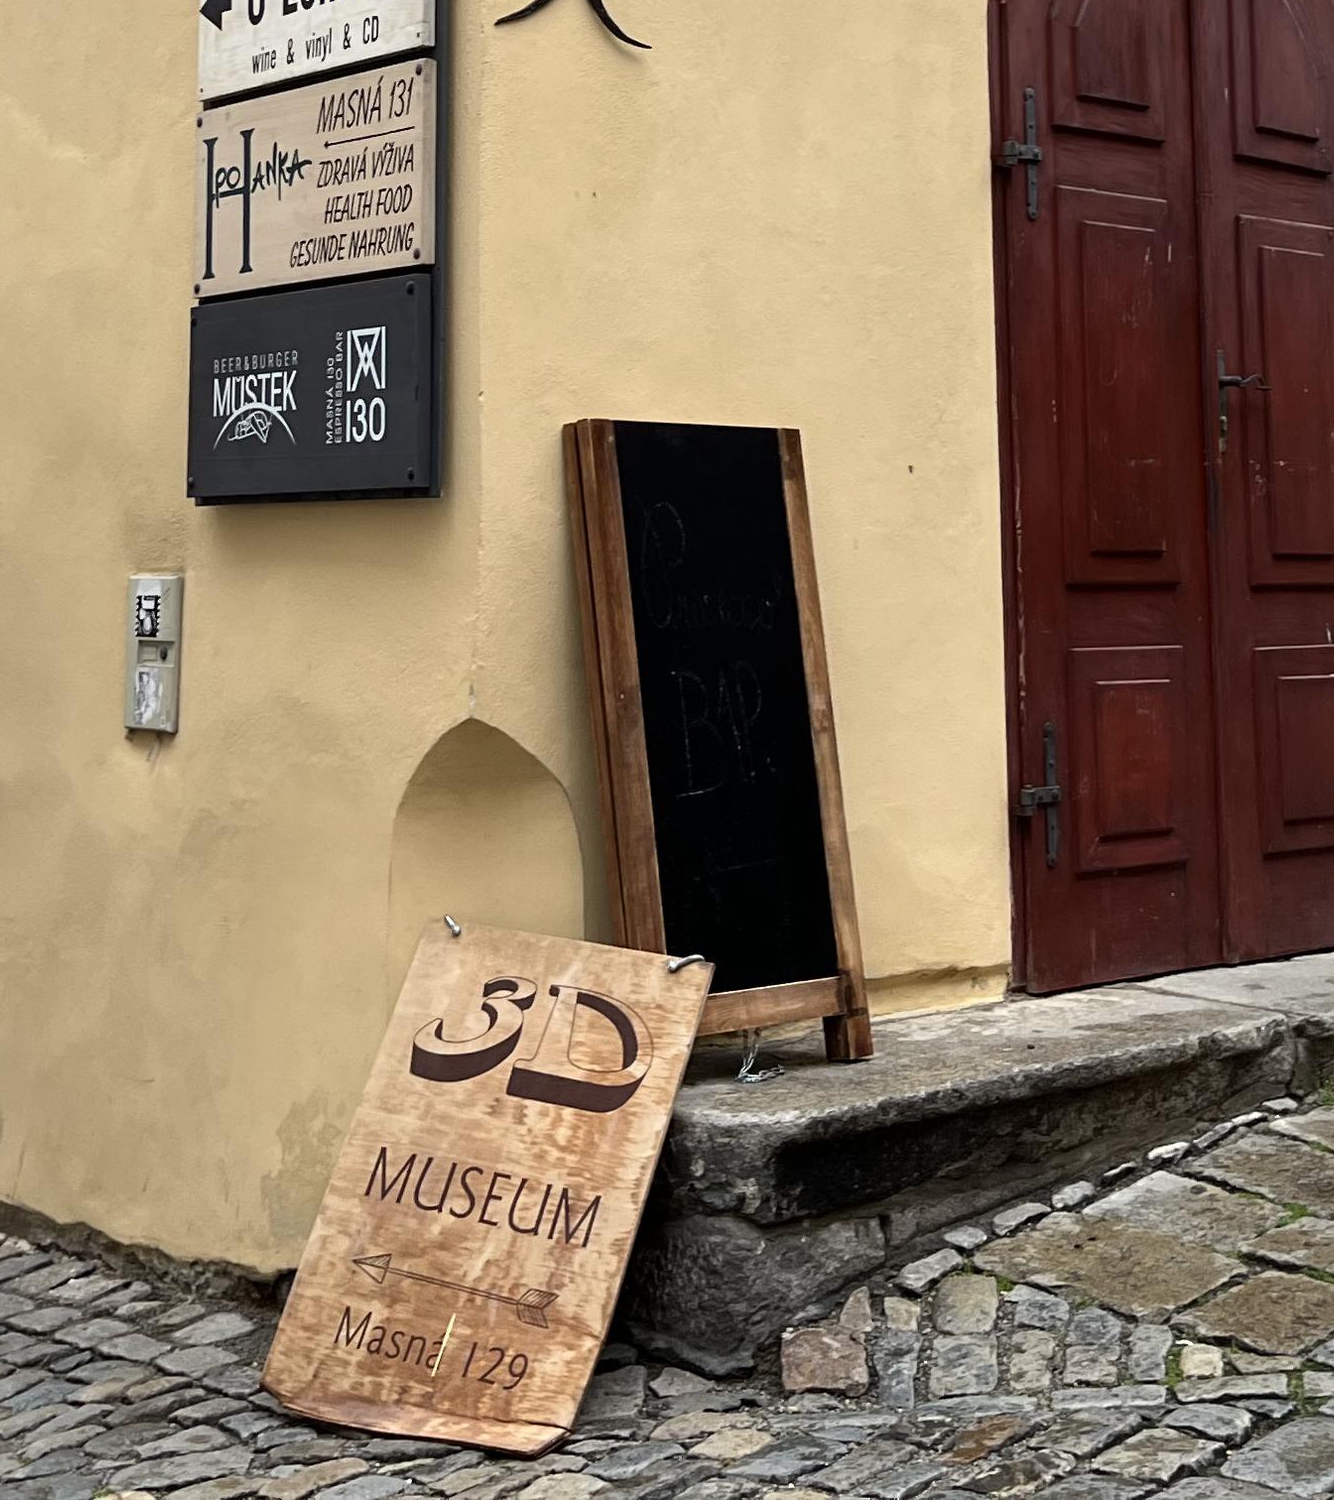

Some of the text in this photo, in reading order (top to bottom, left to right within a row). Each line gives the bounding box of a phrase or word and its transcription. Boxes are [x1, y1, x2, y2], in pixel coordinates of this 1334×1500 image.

[252, 15, 379, 74] wine & vinyl & CD
[317, 75, 415, 134] MASNÁ 131
[317, 141, 414, 188] ZDRAVÁ VÝŽIVA
[324, 184, 413, 224] HEALTH FOOD
[290, 222, 415, 268] GESUNDE NAHRUNG
[346, 397, 386, 442] 130
[410, 976, 653, 1113] 3D
[364, 1146, 602, 1248] MUSEUM
[334, 1306, 528, 1390] Masná 129
